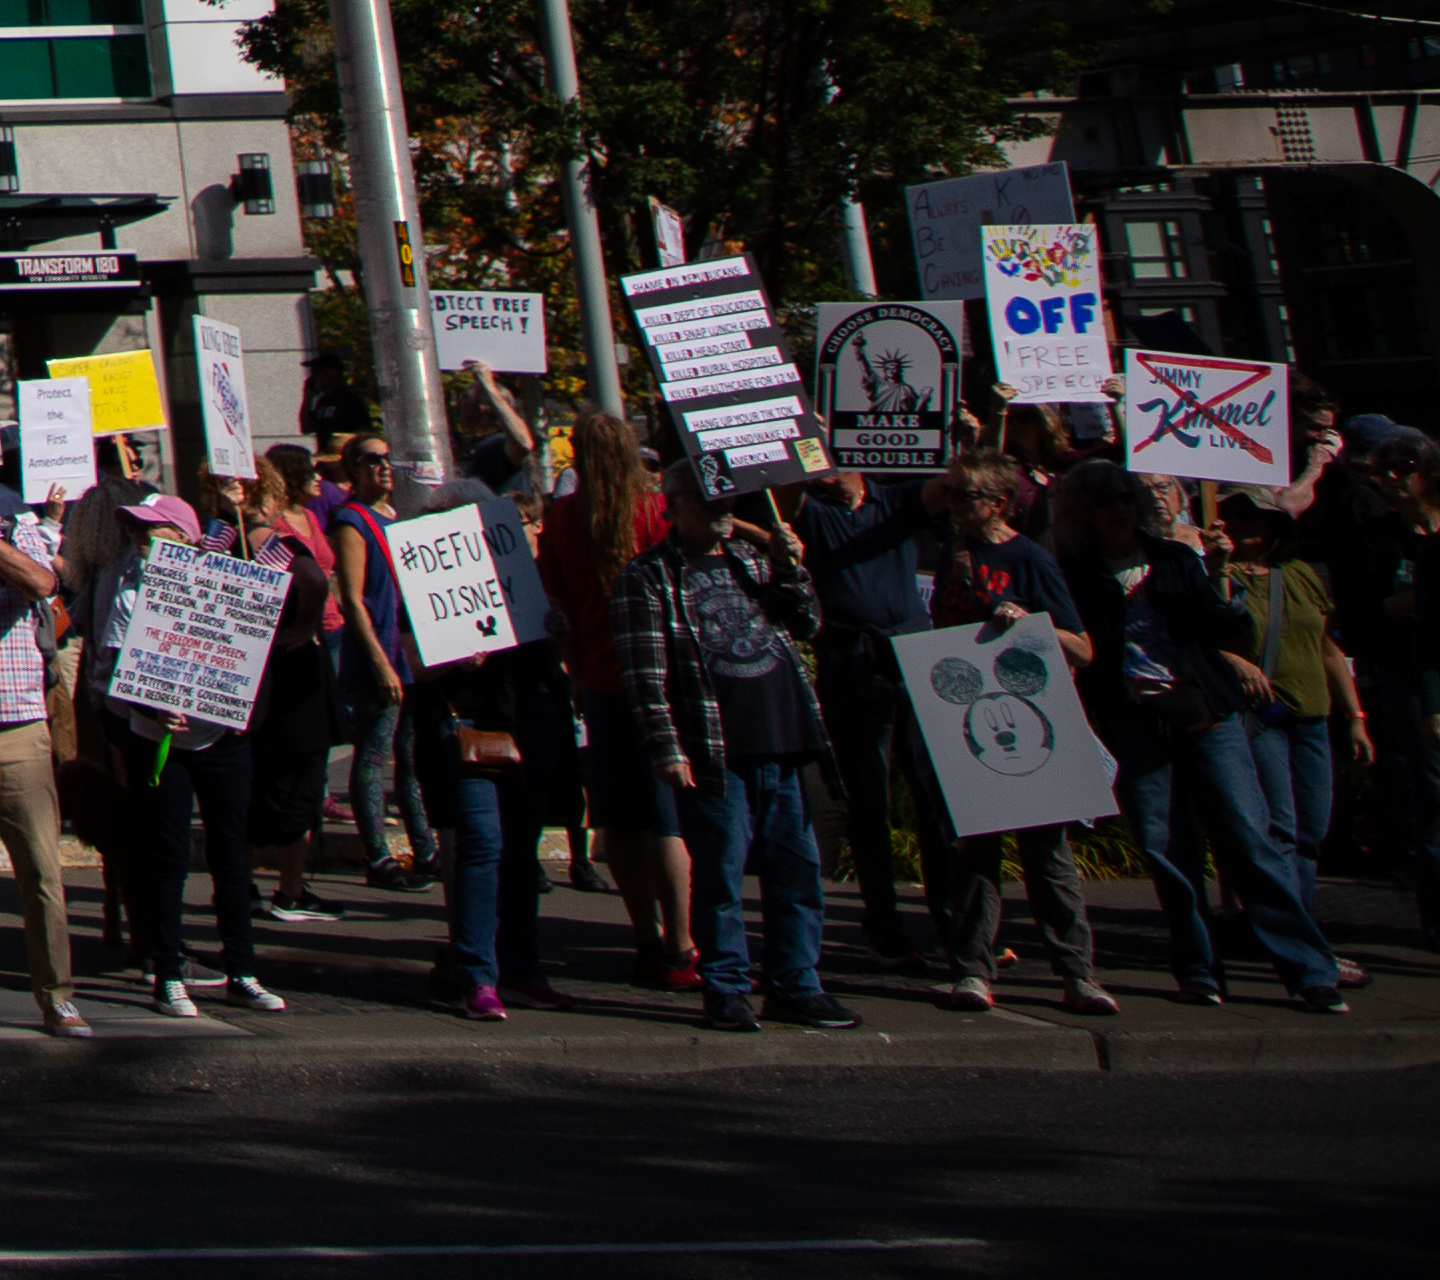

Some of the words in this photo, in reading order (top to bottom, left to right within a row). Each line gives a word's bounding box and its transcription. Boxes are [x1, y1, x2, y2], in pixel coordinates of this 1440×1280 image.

[15, 257, 95, 276] TRANSFORM
[430, 295, 484, 311] OTECT
[492, 297, 531, 313] FREE
[644, 313, 672, 325] KILLED
[697, 305, 710, 317] OF
[710, 298, 762, 316] EDUCATION
[1005, 292, 1097, 336] OFF
[652, 331, 681, 343] KILLED
[826, 310, 874, 354] CHOOSE
[877, 306, 954, 353] DEMOCRACY
[664, 348, 693, 361] KILLED
[720, 339, 748, 352] START
[1017, 345, 1090, 369] FREE
[1017, 374, 1105, 394] SPEECH
[1148, 366, 1203, 389] JIMMY
[36, 388, 73, 400] Protect
[46, 410, 65, 421] the
[855, 413, 922, 428] MAKE
[1136, 389, 1277, 449] Kimmel
[46, 433, 68, 446] First
[856, 432, 921, 447] GOOD
[27, 454, 88, 468] Amendment
[838, 450, 937, 467] TROUBLE
[399, 523, 517, 575] #DEFUND
[159, 542, 201, 565] FIRST
[203, 553, 285, 587] AMENDMENT
[144, 563, 188, 583] CONGRESS
[193, 575, 219, 590] SHALL
[221, 582, 245, 598] MAKE
[251, 591, 265, 602] NO
[142, 574, 192, 597] RESPECTING
[196, 589, 210, 600] AN
[214, 593, 282, 618] ESTABLISHMENT
[427, 576, 516, 622] DISNEY
[144, 587, 157, 600] OF
[203, 602, 218, 615] OR
[224, 607, 279, 630] PROHIBITING
[145, 600, 161, 614] THE
[162, 604, 184, 619] FREE
[188, 611, 227, 630] EXERCISE
